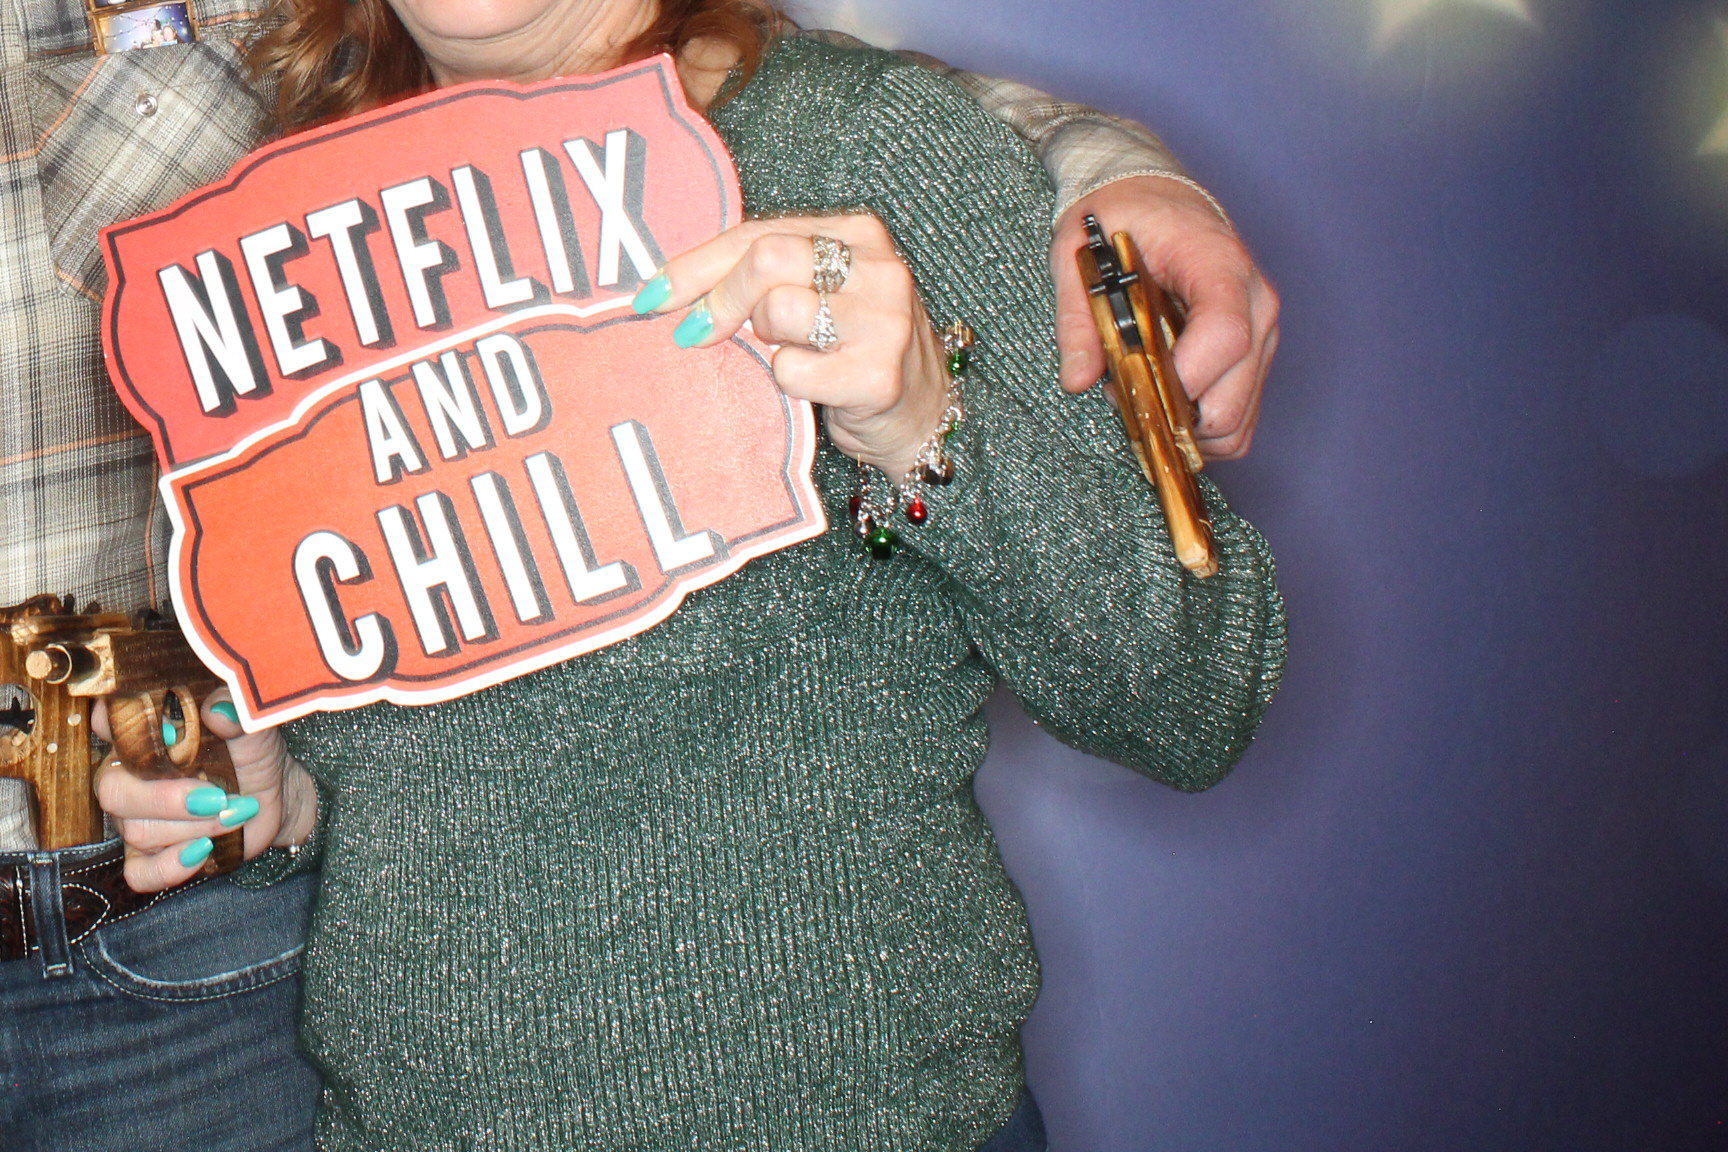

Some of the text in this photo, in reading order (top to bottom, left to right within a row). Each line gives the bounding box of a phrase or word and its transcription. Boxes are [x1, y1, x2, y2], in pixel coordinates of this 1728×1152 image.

[159, 128, 668, 417] NETFLIX
[359, 332, 552, 485] AND
[293, 419, 729, 681] CHILL
